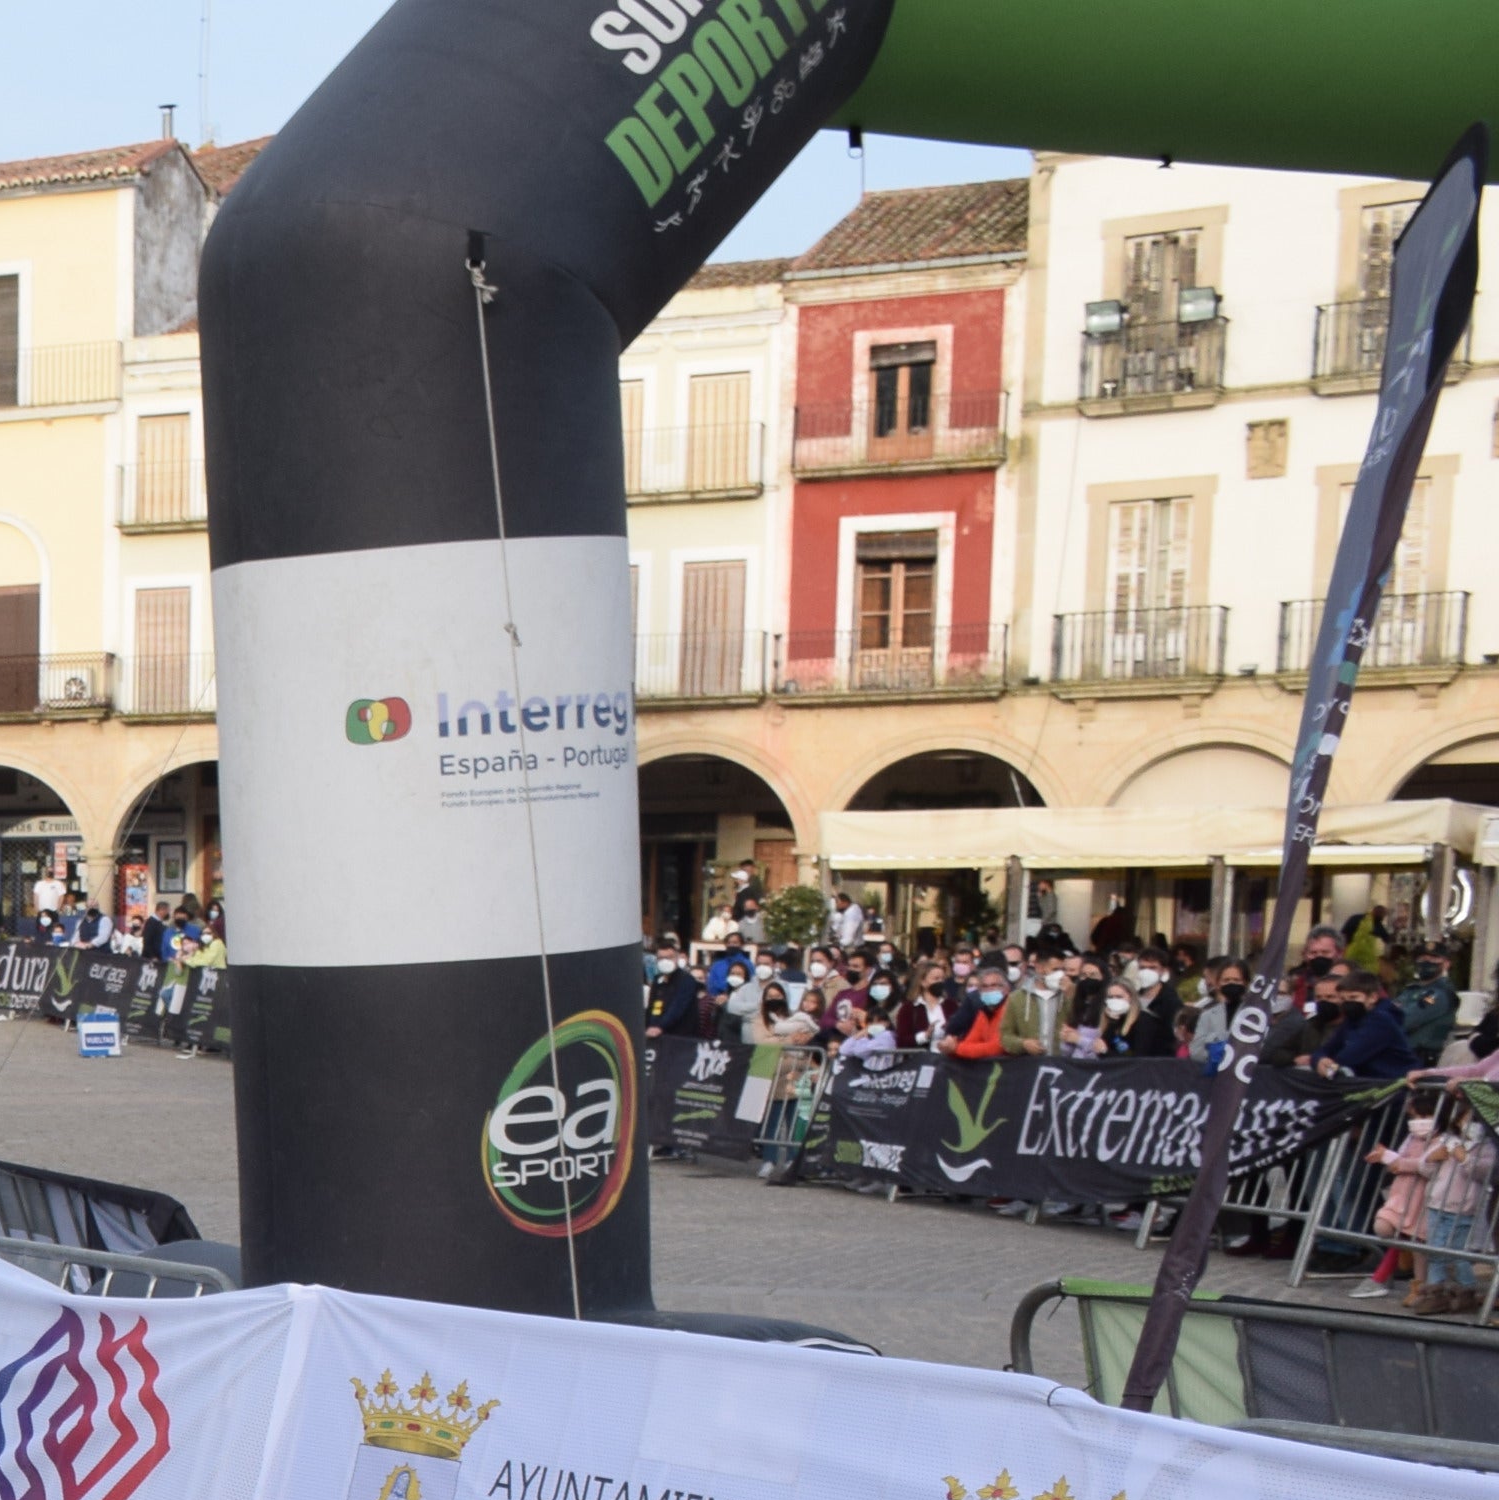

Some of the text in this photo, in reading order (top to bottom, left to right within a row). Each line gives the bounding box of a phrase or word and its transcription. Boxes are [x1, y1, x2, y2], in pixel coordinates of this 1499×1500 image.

[437, 688, 628, 739] Interreg
[439, 751, 539, 780] España
[563, 744, 630, 773] Portugal
[492, 1149, 615, 1188] SPORT
